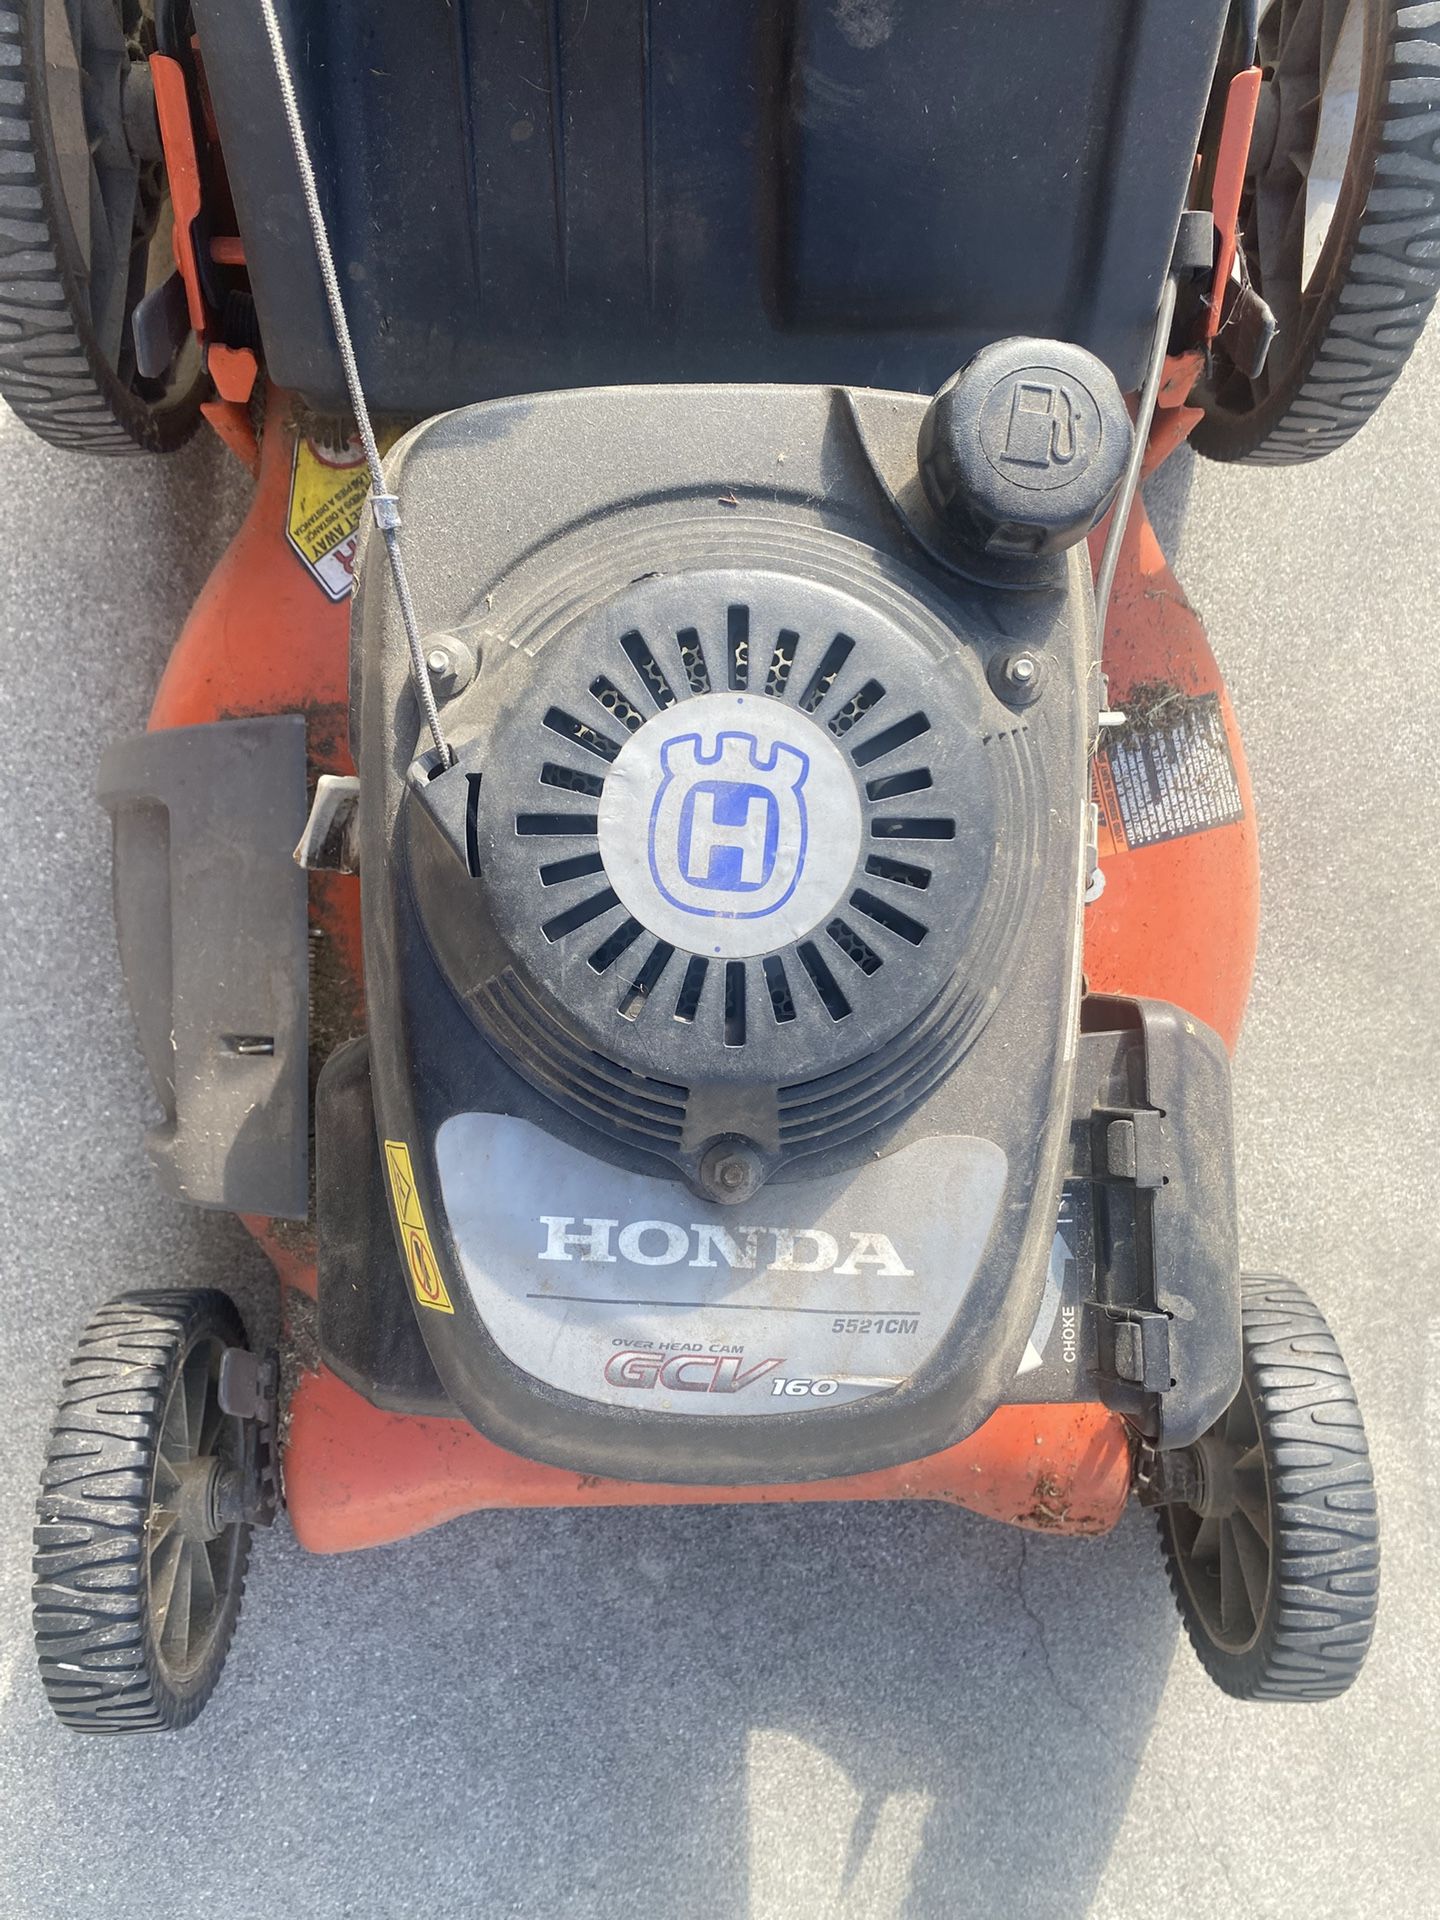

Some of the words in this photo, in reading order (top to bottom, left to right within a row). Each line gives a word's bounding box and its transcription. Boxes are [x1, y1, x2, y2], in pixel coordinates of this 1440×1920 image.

[311, 523, 345, 558] AWAY
[538, 1215, 914, 1277] HONDA
[611, 1338, 654, 1349] OVER
[658, 1342, 702, 1352] HEAD
[708, 1344, 744, 1354] CAM
[831, 1318, 919, 1335] 5521CM
[1062, 1306, 1076, 1362] CHOKE
[604, 1350, 787, 1393] GCV
[771, 1378, 839, 1397] 160
